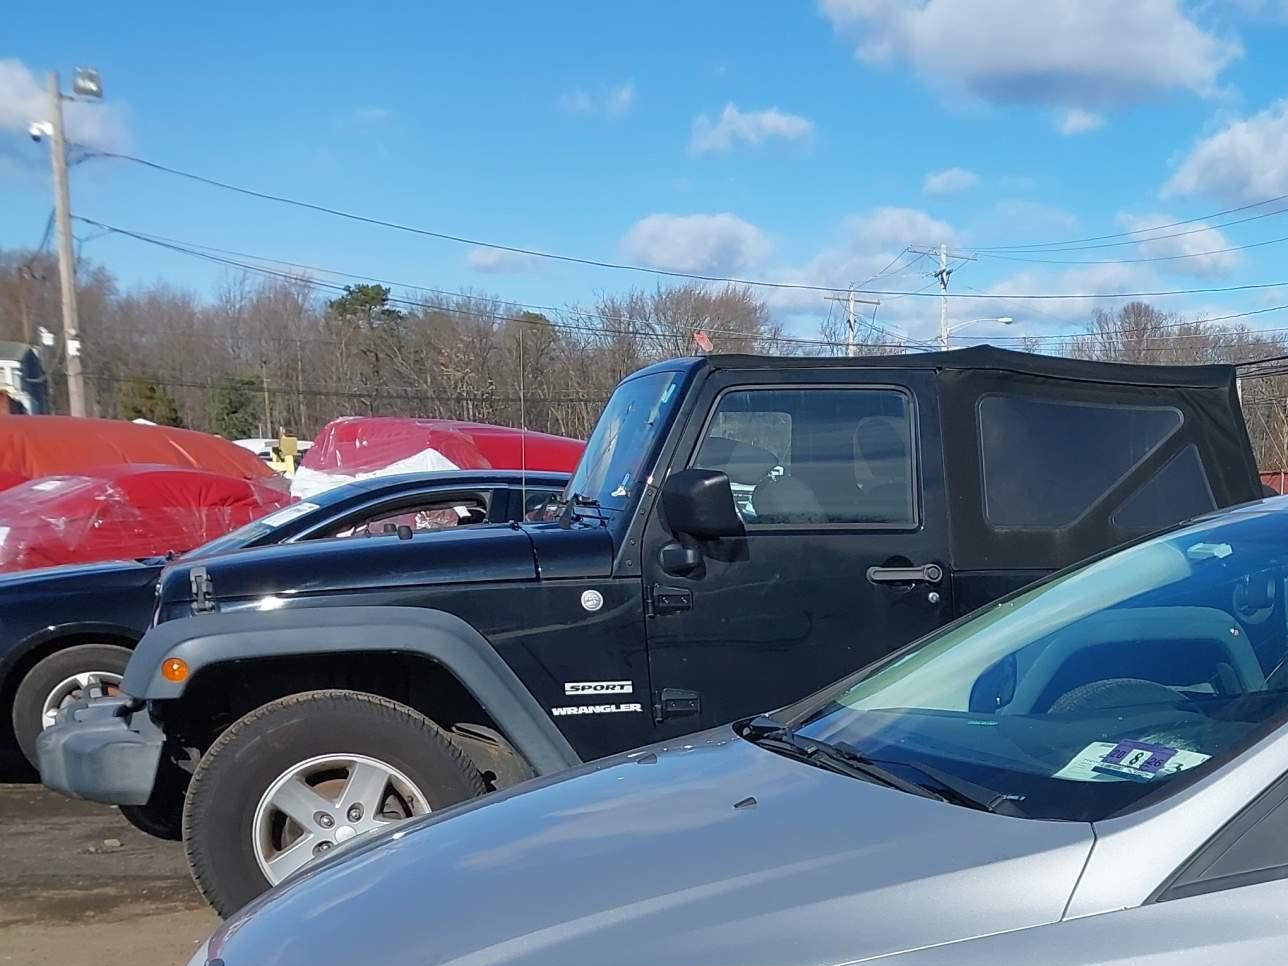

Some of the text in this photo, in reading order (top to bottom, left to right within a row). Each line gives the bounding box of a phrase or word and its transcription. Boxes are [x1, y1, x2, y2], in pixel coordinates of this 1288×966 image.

[567, 684, 632, 692] SPORT
[552, 703, 643, 716] WRANGLER
[1110, 749, 1163, 767] 20 8 26
